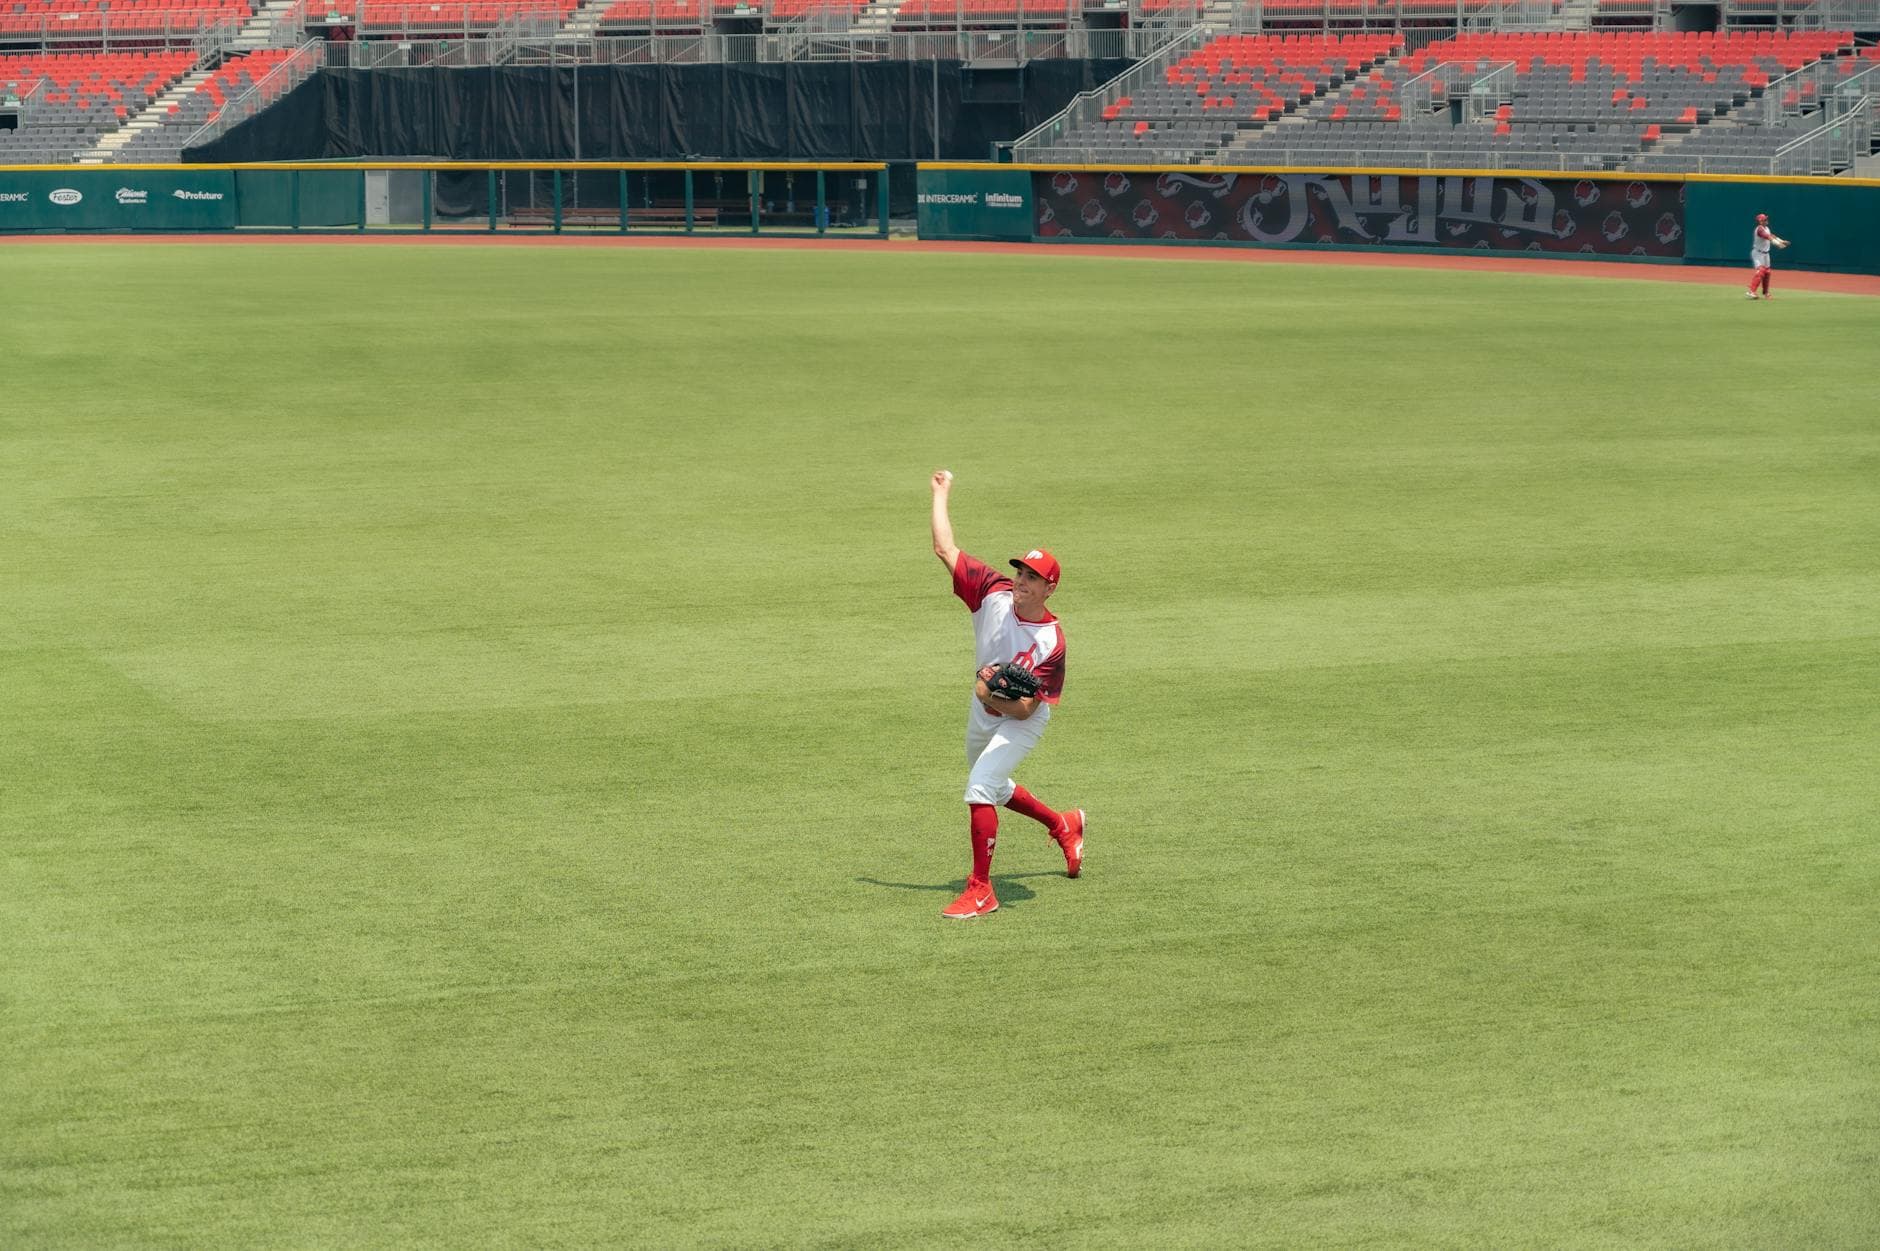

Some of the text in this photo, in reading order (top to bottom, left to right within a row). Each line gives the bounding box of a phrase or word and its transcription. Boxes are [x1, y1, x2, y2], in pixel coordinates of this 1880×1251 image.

[0, 193, 28, 202] ERAMIC
[185, 191, 223, 200] Profuturo
[926, 194, 977, 203] INTERCERAMIC
